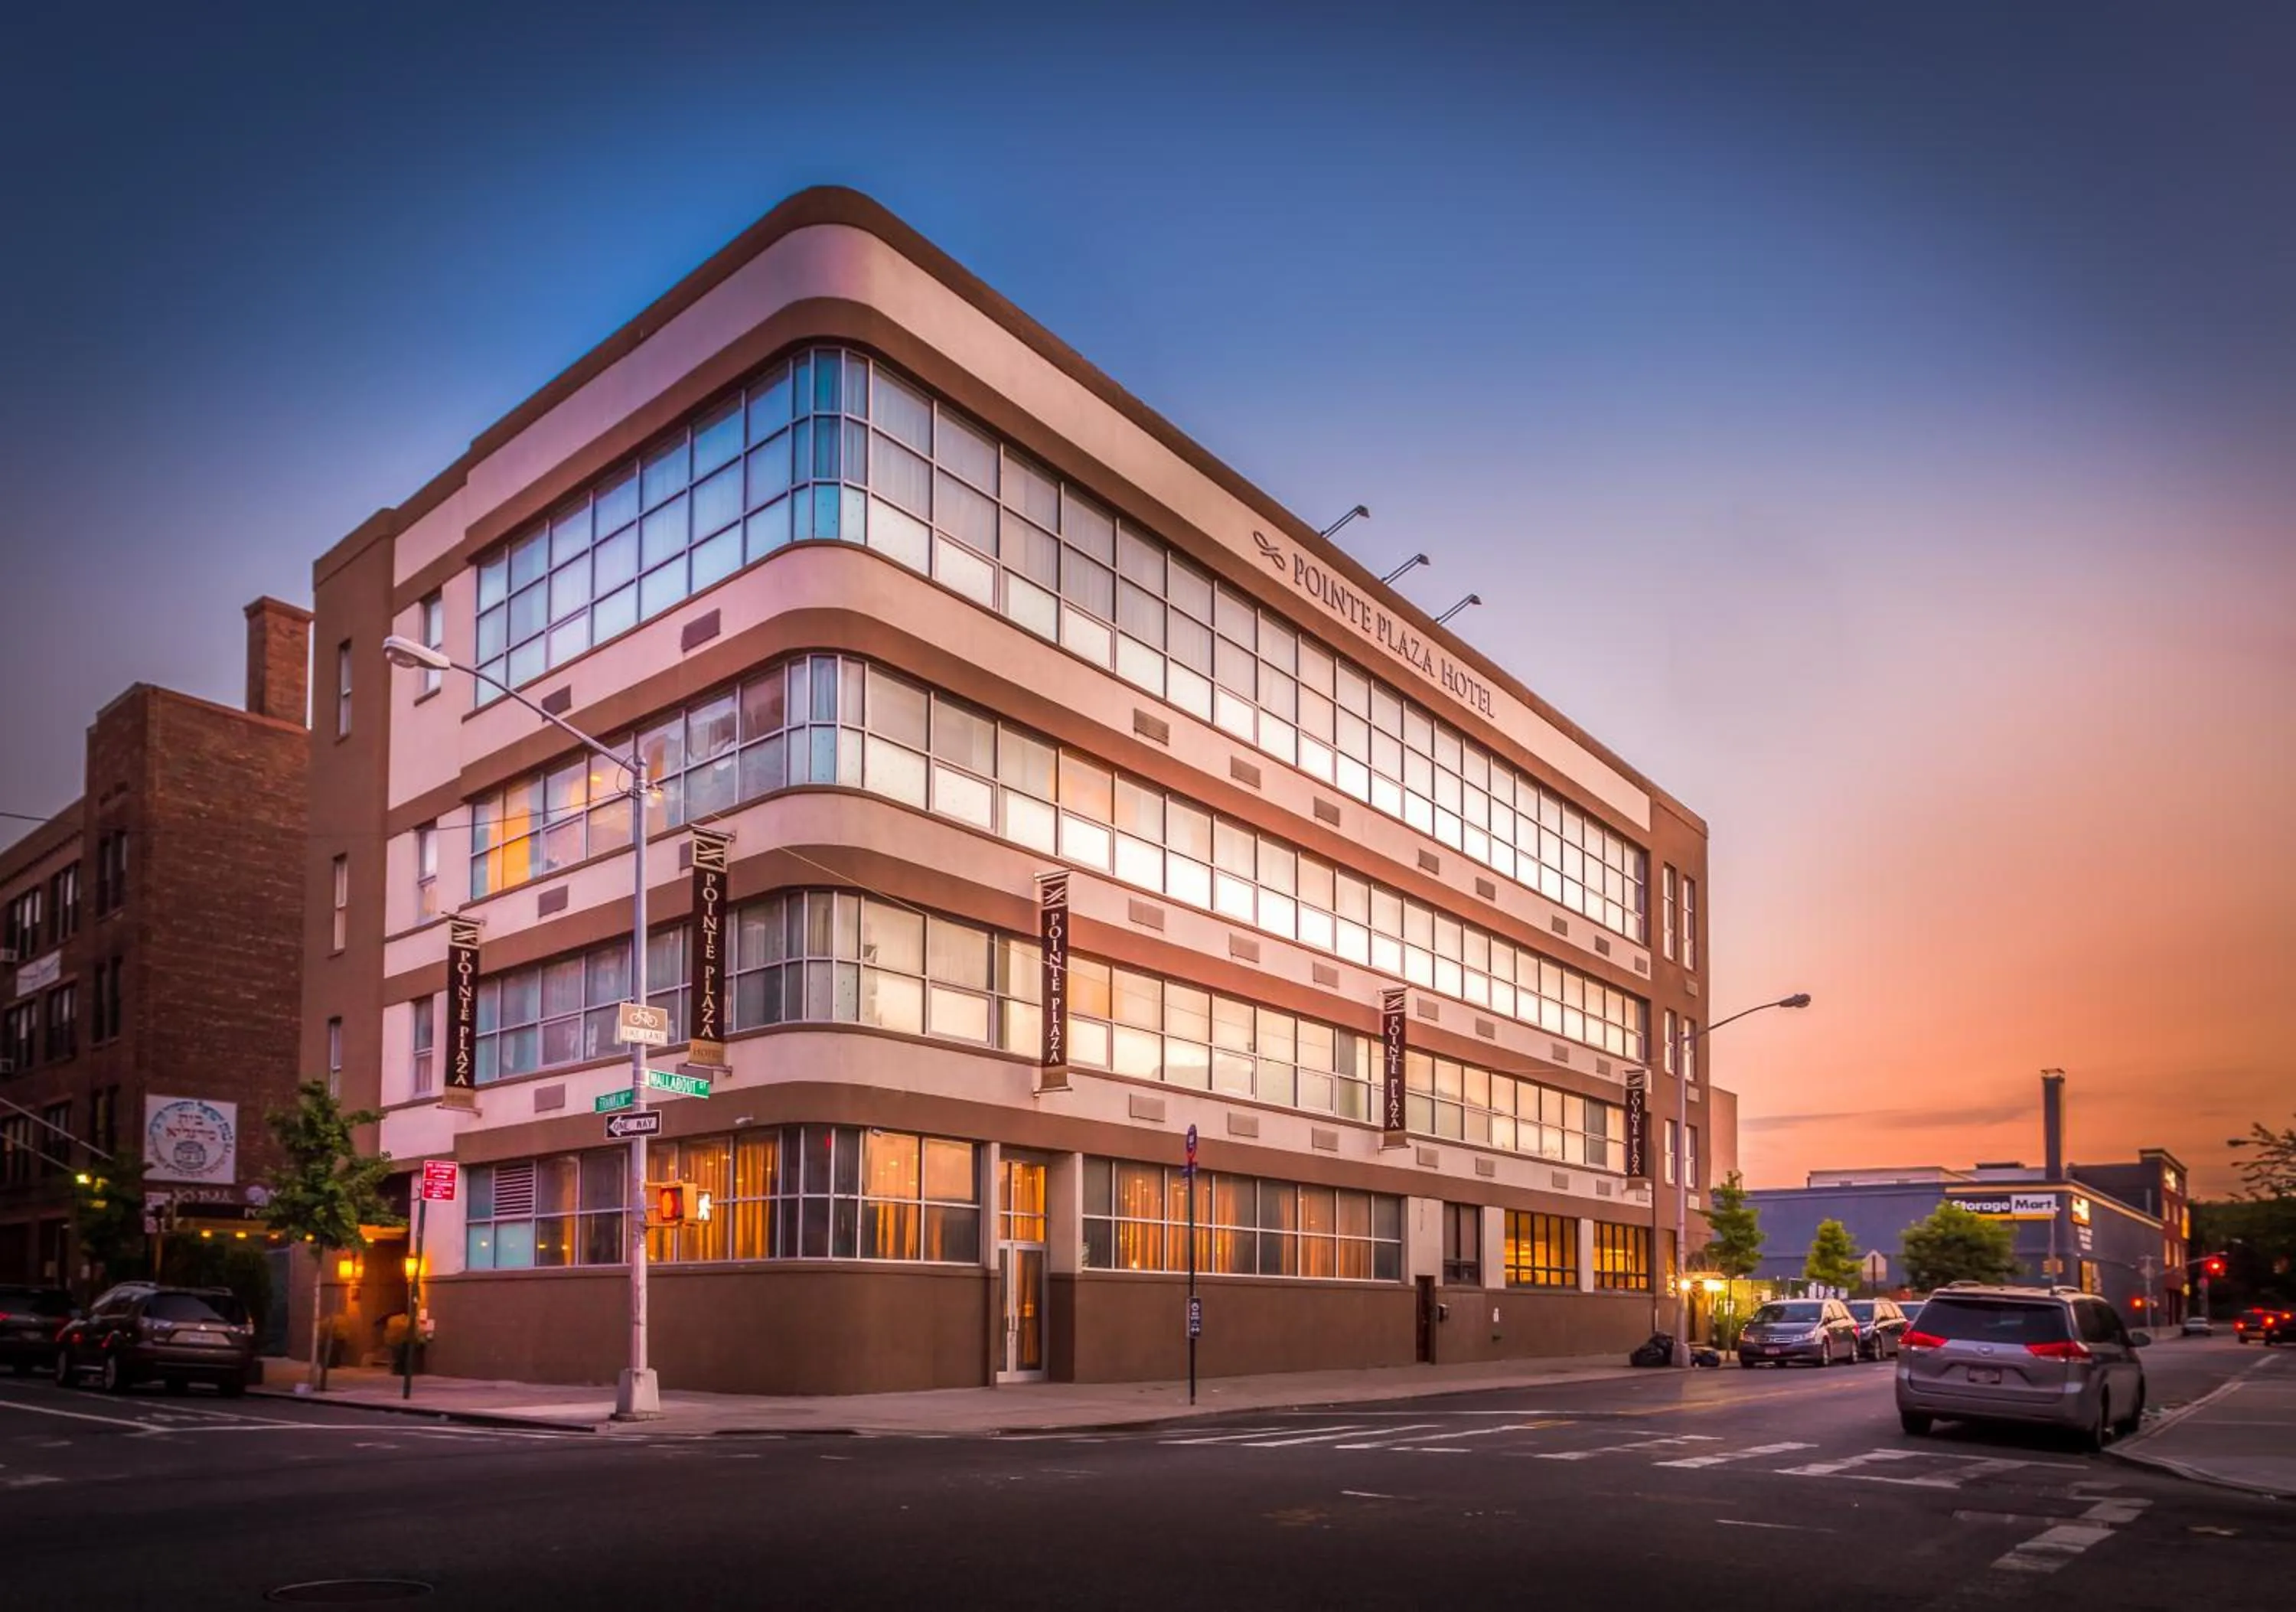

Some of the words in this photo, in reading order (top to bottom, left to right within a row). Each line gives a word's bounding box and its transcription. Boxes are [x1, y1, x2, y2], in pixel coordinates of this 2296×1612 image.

[1293, 553, 1371, 633] POINTE
[1376, 612, 1436, 677] PLAZA
[1440, 658, 1495, 719] HOTEL
[702, 873, 718, 960] POINTE
[1049, 913, 1062, 992] POINTE
[458, 949, 472, 1022] POINTE
[701, 965, 716, 1038] PLAZA
[455, 1025, 470, 1086] PLAZA
[644, 1030, 663, 1042] LANE
[693, 1047, 722, 1059] HOT
[1049, 997, 1060, 1063] PLAZA
[1388, 1016, 1400, 1075] POINTE
[651, 1071, 696, 1094] WALLABOUT
[1389, 1078, 1399, 1128] PLAZA
[614, 1122, 629, 1132] ONE
[636, 1118, 653, 1129] WAY
[1631, 1089, 1641, 1135] POINTE
[1631, 1138, 1640, 1176] PLAZA
[2014, 1199, 2053, 1210] Mart
